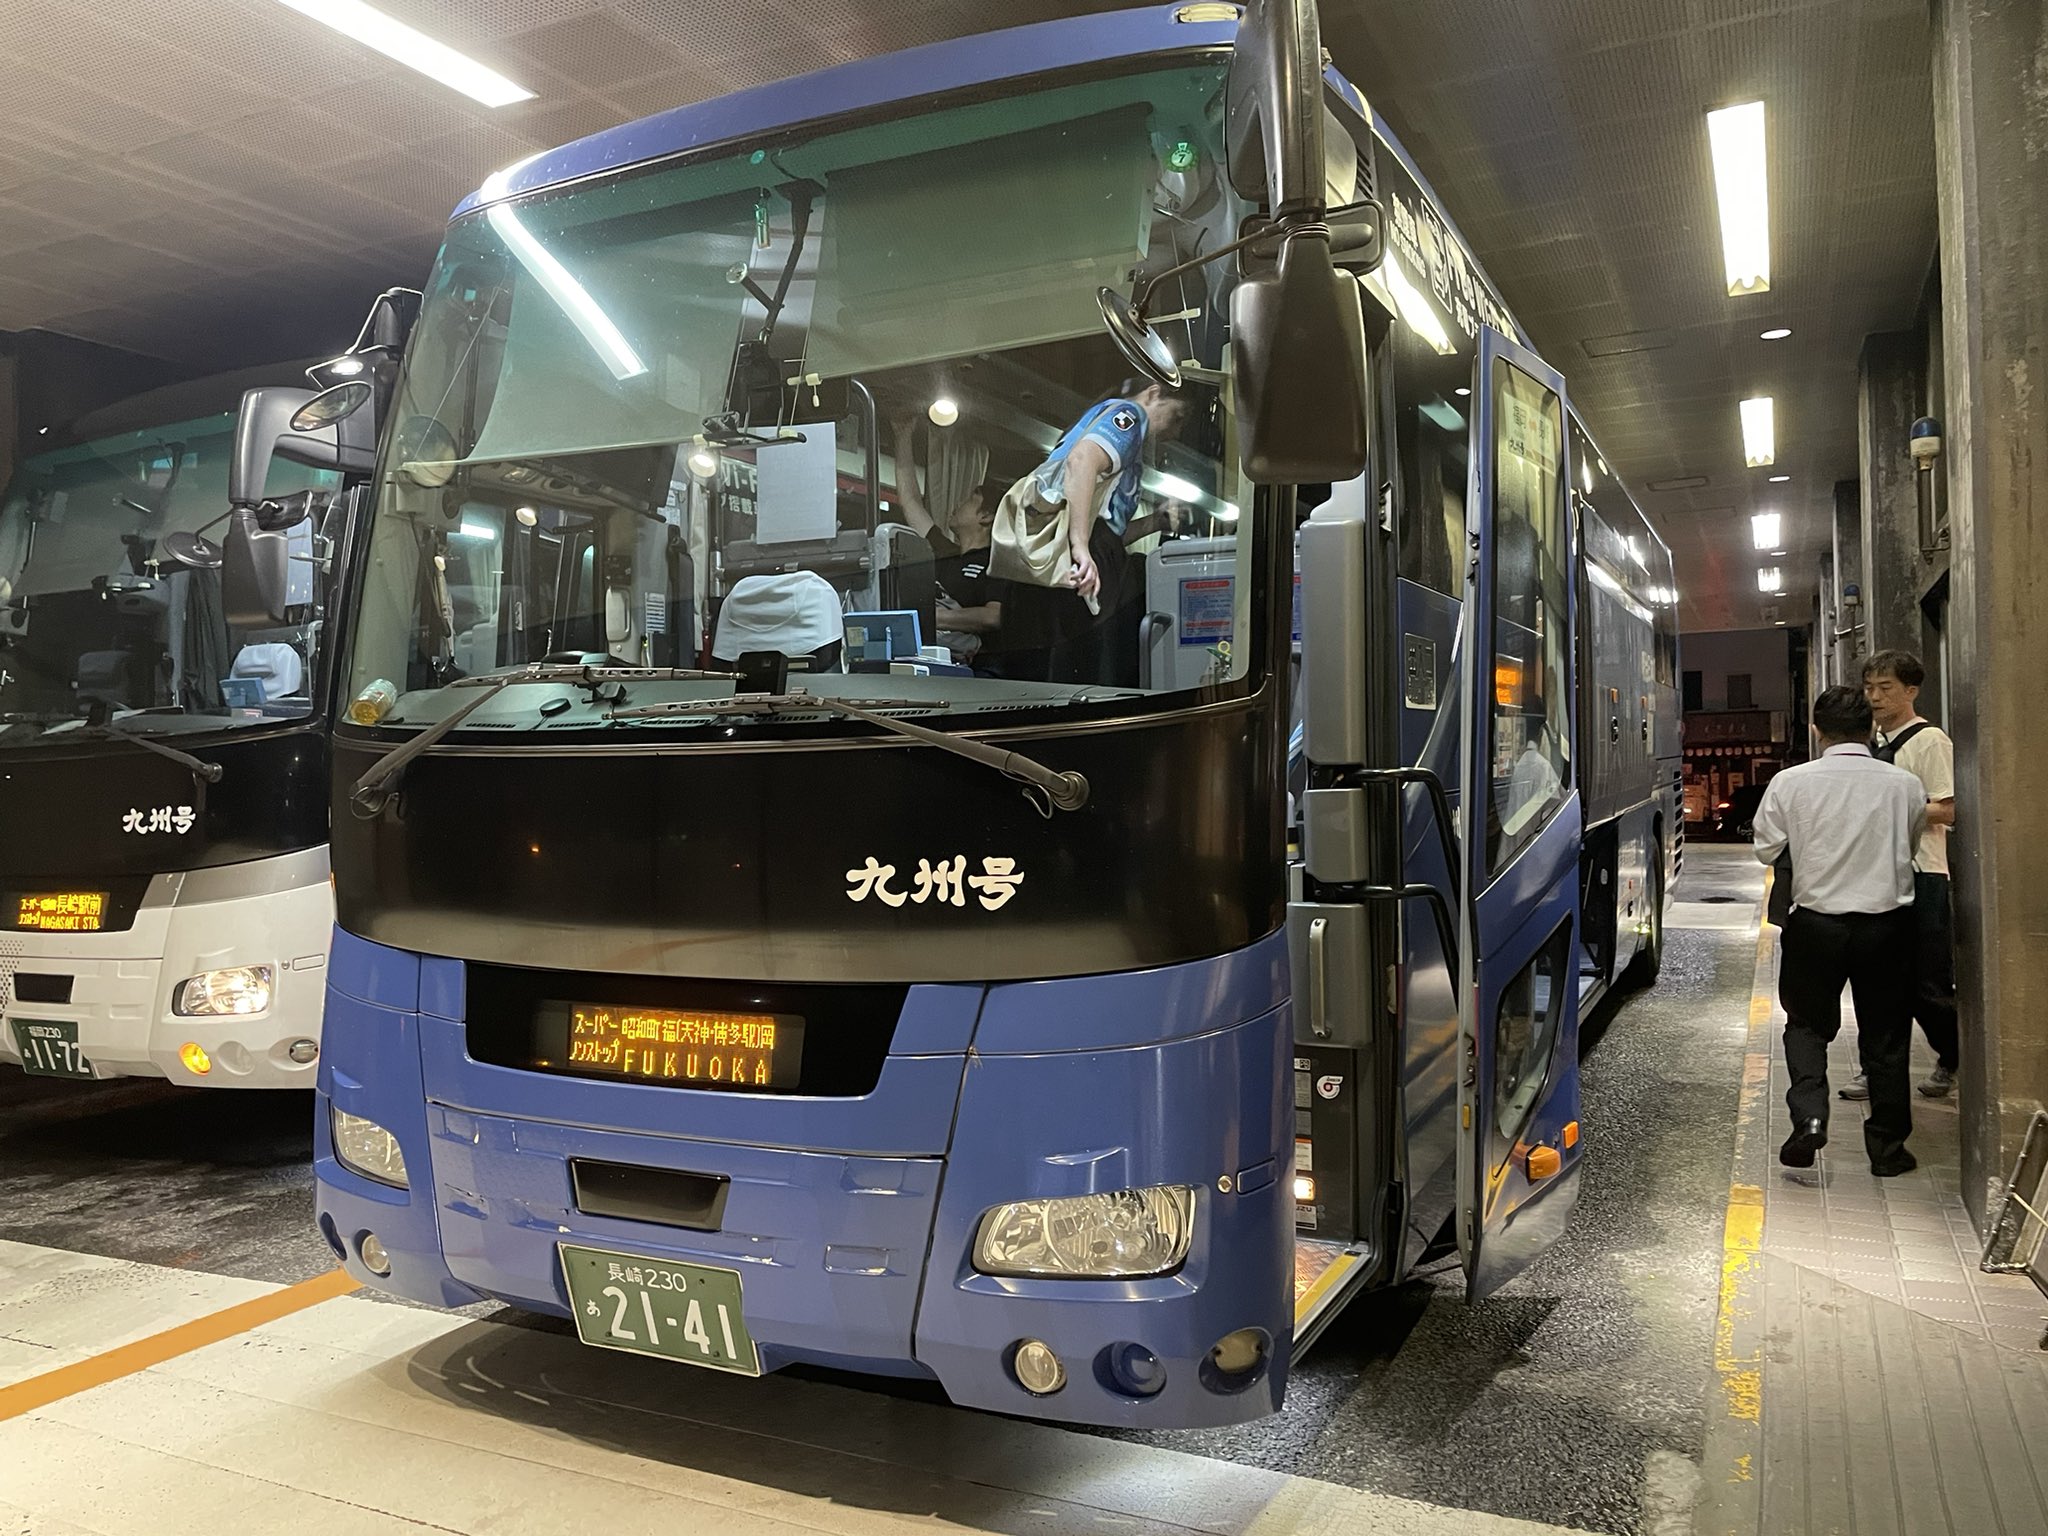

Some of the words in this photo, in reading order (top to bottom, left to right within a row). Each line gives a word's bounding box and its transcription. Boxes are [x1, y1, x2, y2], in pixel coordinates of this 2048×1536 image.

[122, 805, 197, 835] 九州号
[845, 854, 1025, 911] 九州号
[57, 894, 102, 915] 長崎駅前
[40, 916, 80, 930] NAGASAKI
[574, 1013, 619, 1035] スーパー
[569, 1037, 620, 1063] ノンストップ
[586, 1299, 601, 1318] あ
[601, 1285, 737, 1360] 21-41
